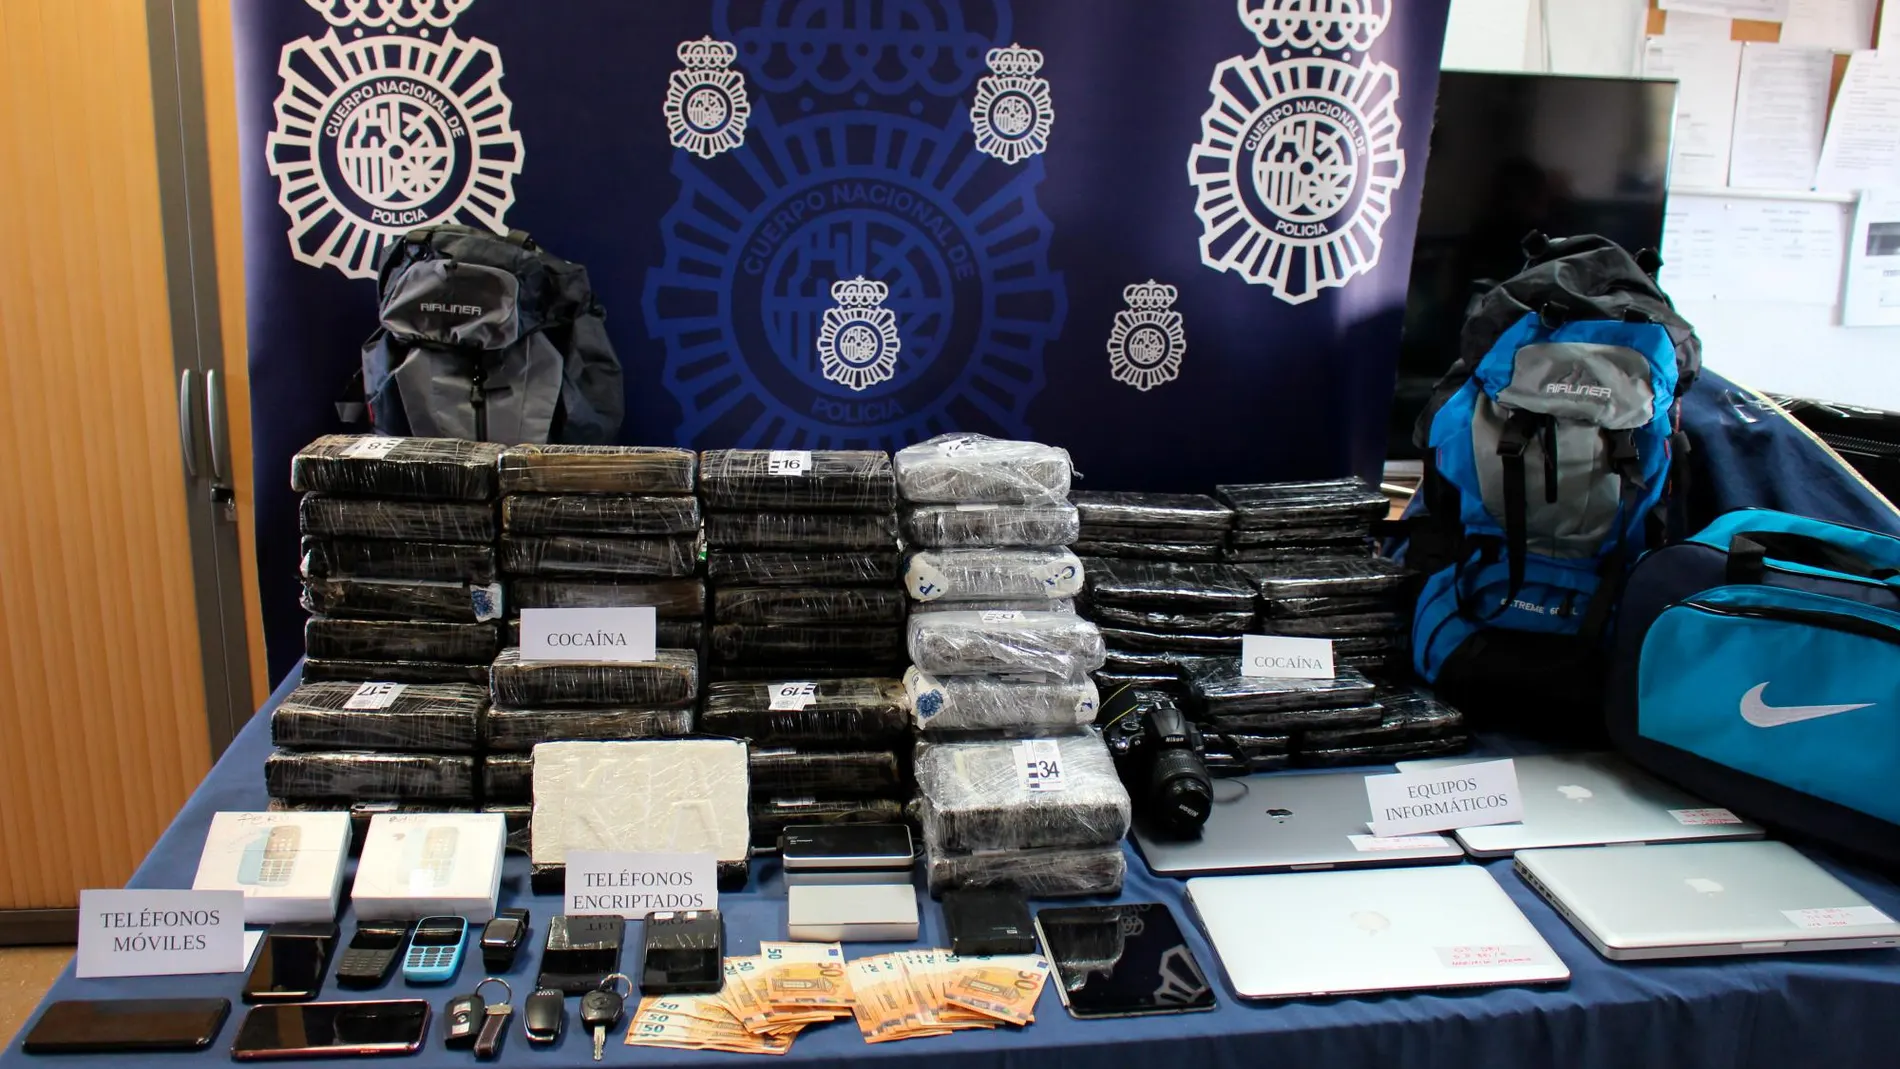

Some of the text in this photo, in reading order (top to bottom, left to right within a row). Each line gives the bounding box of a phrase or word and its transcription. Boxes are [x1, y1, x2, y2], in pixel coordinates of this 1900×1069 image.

[325, 80, 465, 139] CUERPO NACIONAL DE
[1244, 100, 1367, 157] CUERPO NACIONAL DE
[371, 208, 428, 225] POLICIA
[743, 183, 975, 281] CUERPO NACIONAL DE
[1274, 219, 1328, 236] POLICIA
[420, 302, 482, 316] AIRLINER
[1546, 383, 1612, 398] AIRLINER
[811, 397, 904, 422] POLICIA
[782, 459, 800, 469] 16
[1500, 597, 1545, 614] ETREME
[546, 629, 628, 647] COCAÍNA
[1254, 655, 1323, 670] COCAÍNA
[1038, 760, 1060, 778] 34
[1407, 777, 1478, 799] EQUIPOS
[1385, 793, 1509, 821] INFORMÁTICOS
[584, 869, 693, 888] TELÉFONOS
[573, 893, 704, 910] ENCRIPTADOS
[100, 907, 220, 929] TELÉFONOS
[113, 932, 207, 952] MÓVILES
[767, 947, 782, 960] 50
[818, 962, 844, 978] 50
[1014, 969, 1043, 992] 50
[656, 1001, 680, 1011] 50
[647, 1013, 670, 1023] 50
[642, 1023, 666, 1034] 50
